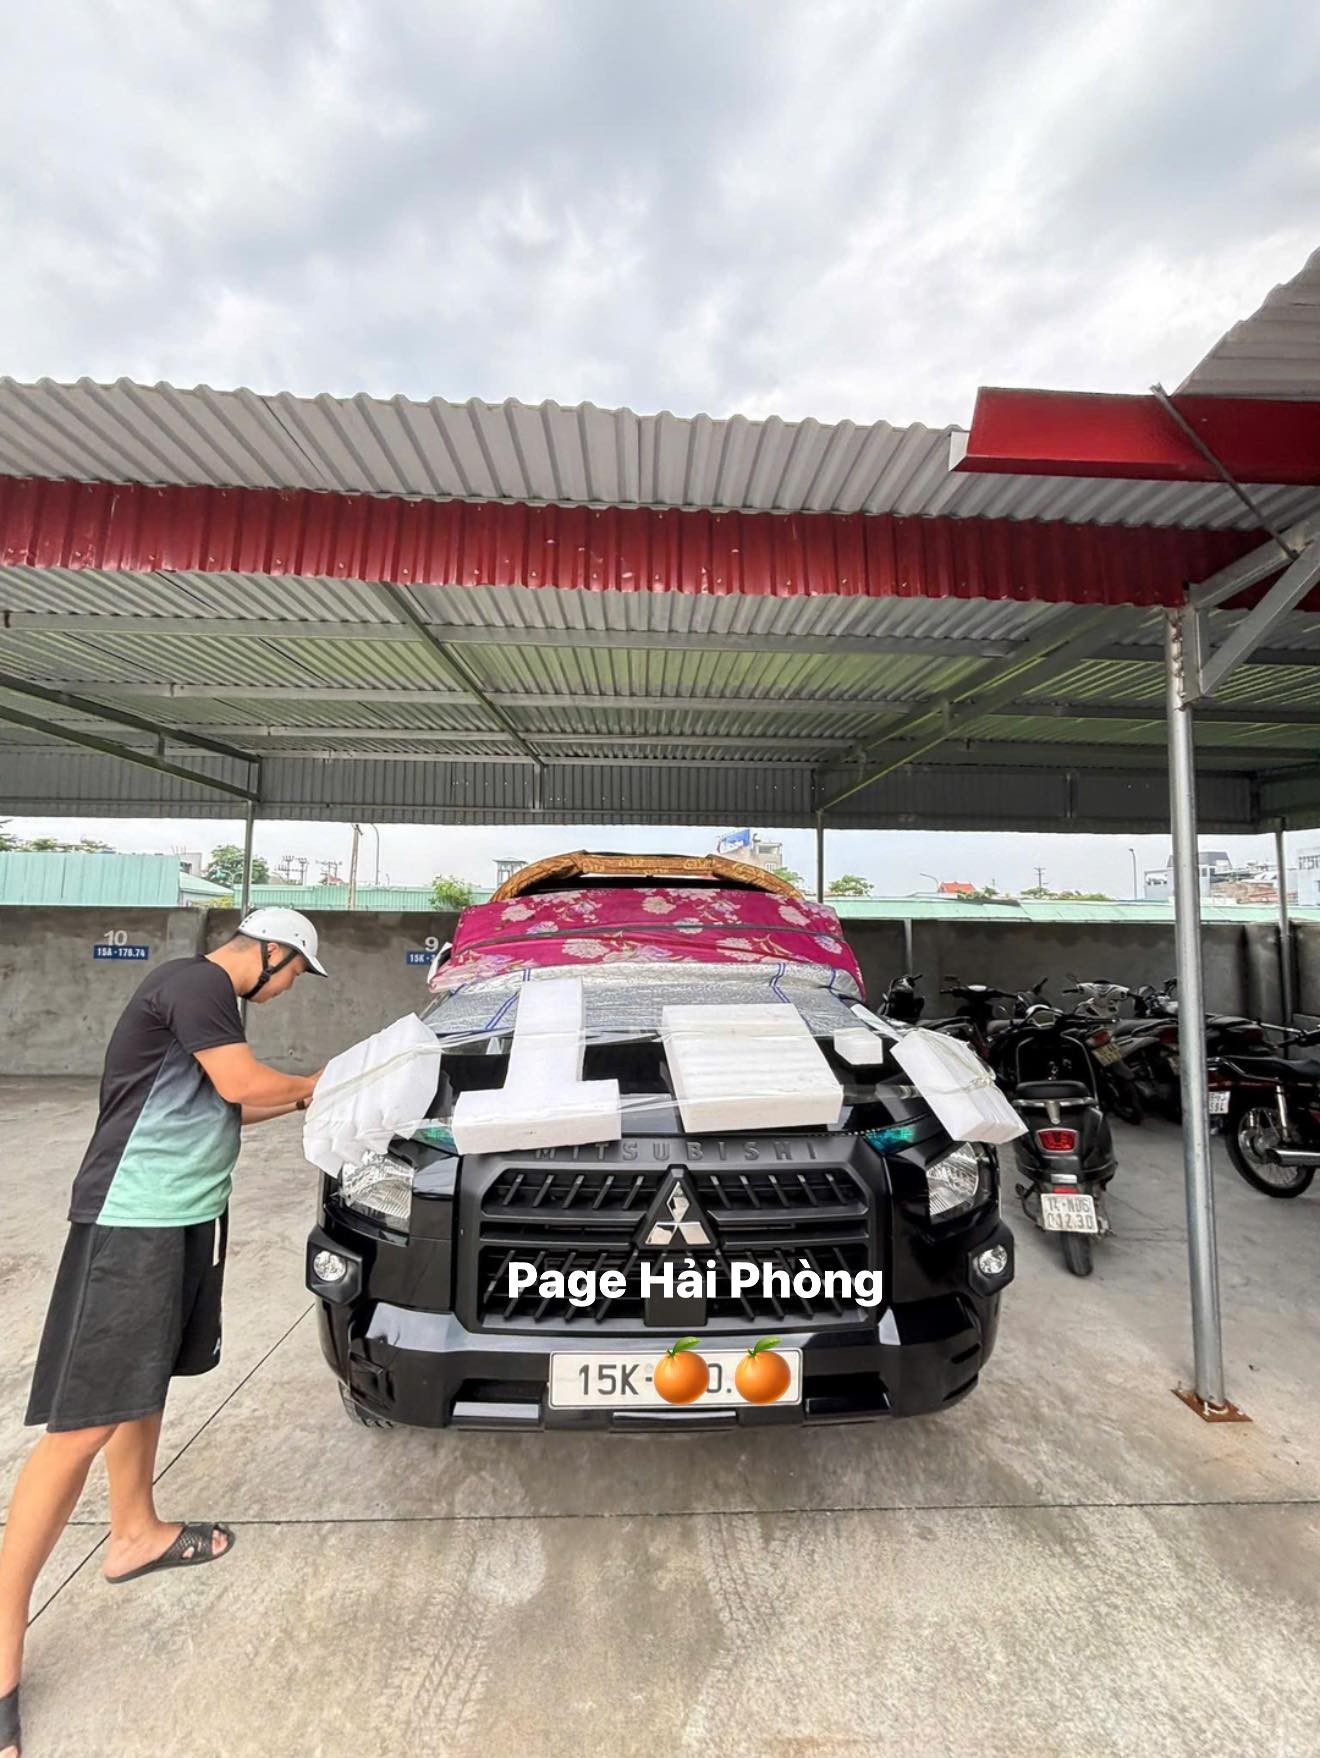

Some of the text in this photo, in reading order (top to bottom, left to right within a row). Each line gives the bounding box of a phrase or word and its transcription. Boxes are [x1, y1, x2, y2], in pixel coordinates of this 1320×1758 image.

[103, 930, 128, 946] 10
[424, 936, 439, 952] 9
[534, 1140, 818, 1161] MITSUBISHI
